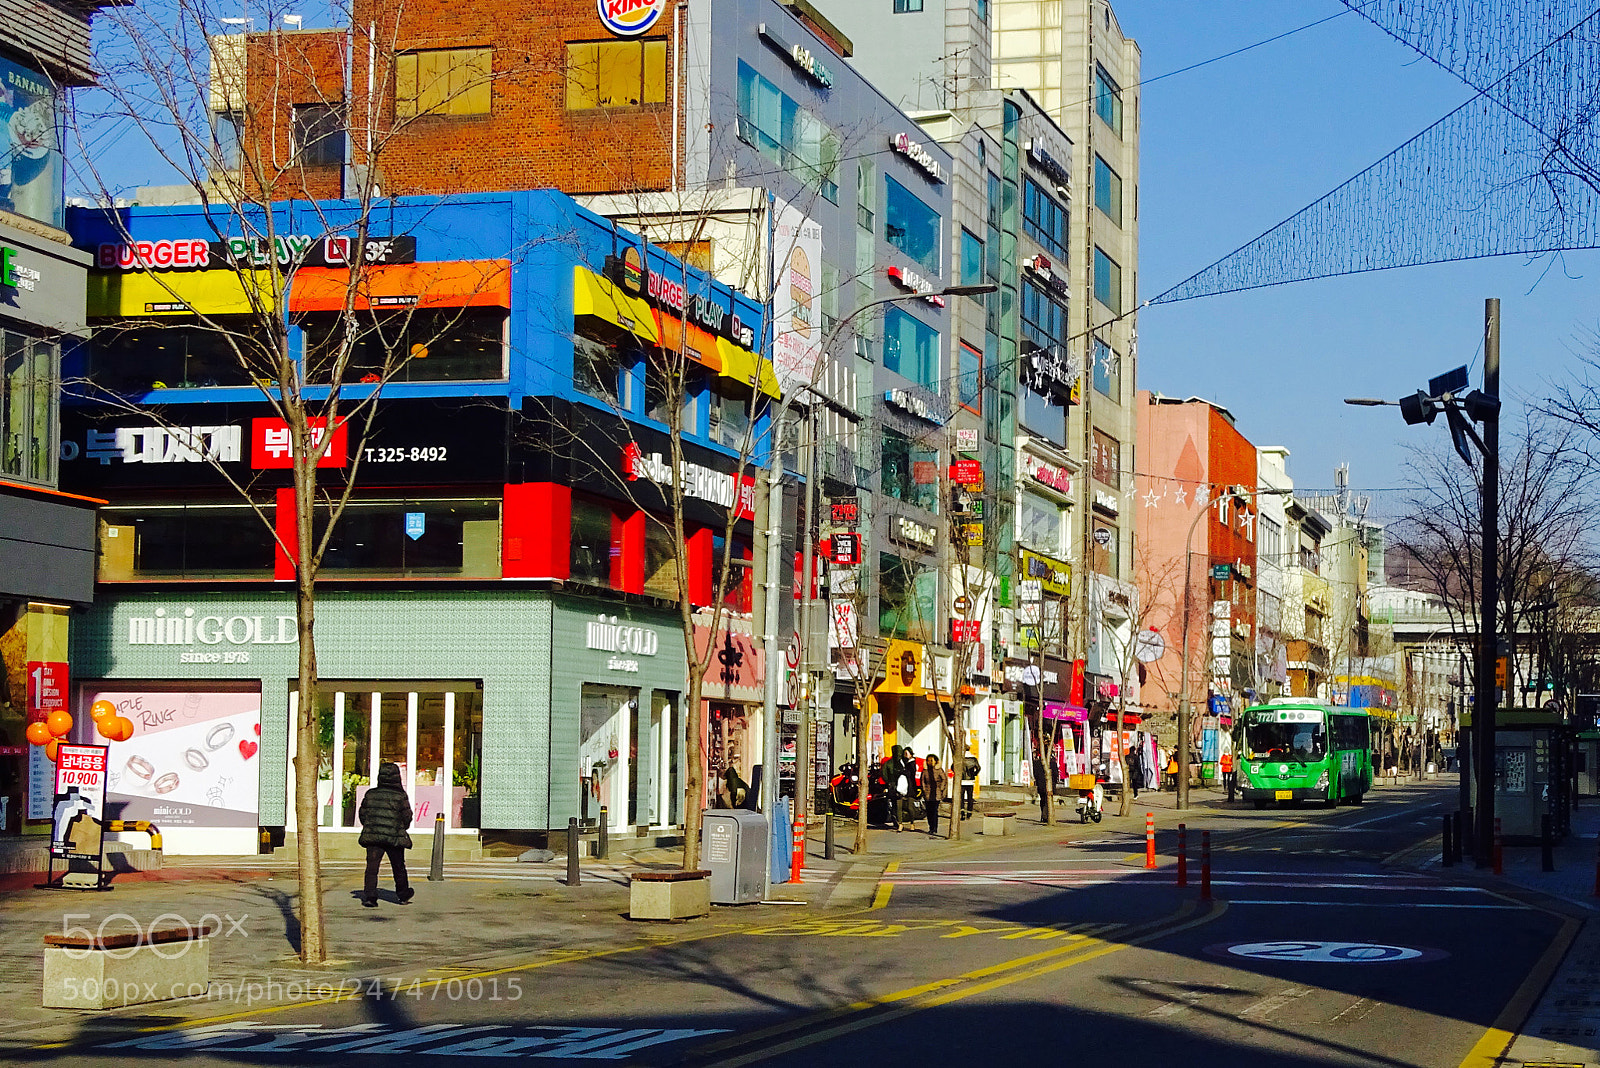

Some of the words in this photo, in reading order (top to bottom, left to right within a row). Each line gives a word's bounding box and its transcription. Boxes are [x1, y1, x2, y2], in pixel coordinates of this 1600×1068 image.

[100, 239, 209, 270] BURGER
[226, 235, 313, 266] PLAY
[364, 240, 394, 263] 3F
[790, 270, 812, 295] BURGER
[648, 270, 688, 312] BURGE
[695, 296, 723, 331] PLAY
[86, 425, 242, 465] 부대찌개
[364, 446, 447, 463] T.325-8492
[682, 461, 735, 508] 부대찌개
[129, 607, 300, 645] miniGOLD
[586, 613, 659, 656] miniGOLD
[180, 651, 221, 664] since
[222, 651, 250, 664] 1978
[42, 698, 63, 707] PRODUCT
[136, 709, 176, 731] RING
[1257, 712, 1274, 723] 7727
[62, 755, 103, 770] 남녀공용
[153, 805, 192, 815] miniGOLD
[414, 801, 430, 822] ift
[1244, 943, 1403, 960] 20
